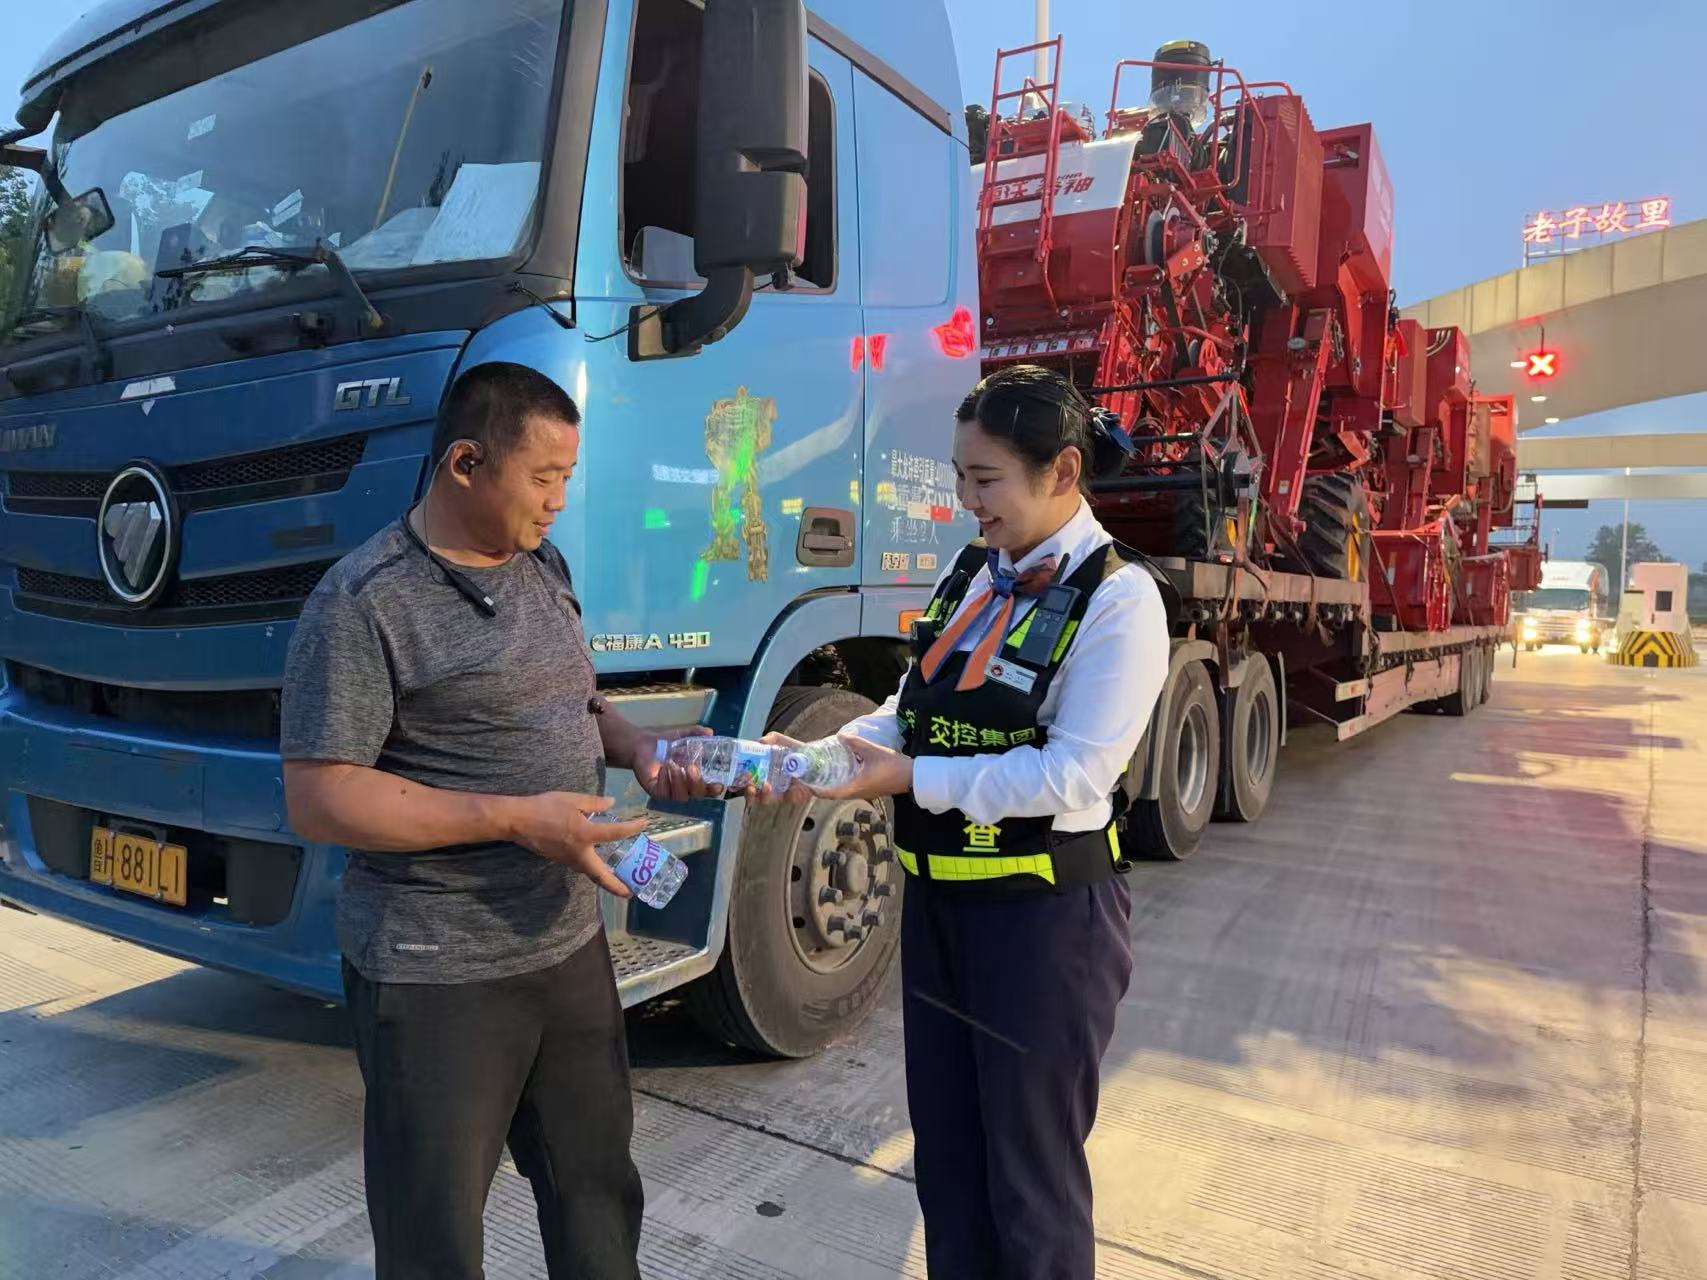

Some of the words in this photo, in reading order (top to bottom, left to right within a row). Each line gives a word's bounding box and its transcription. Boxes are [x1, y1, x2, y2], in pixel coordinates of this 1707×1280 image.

[1523, 197, 1671, 243] 老子故里
[336, 377, 410, 411] GTL
[668, 631, 711, 650] 490
